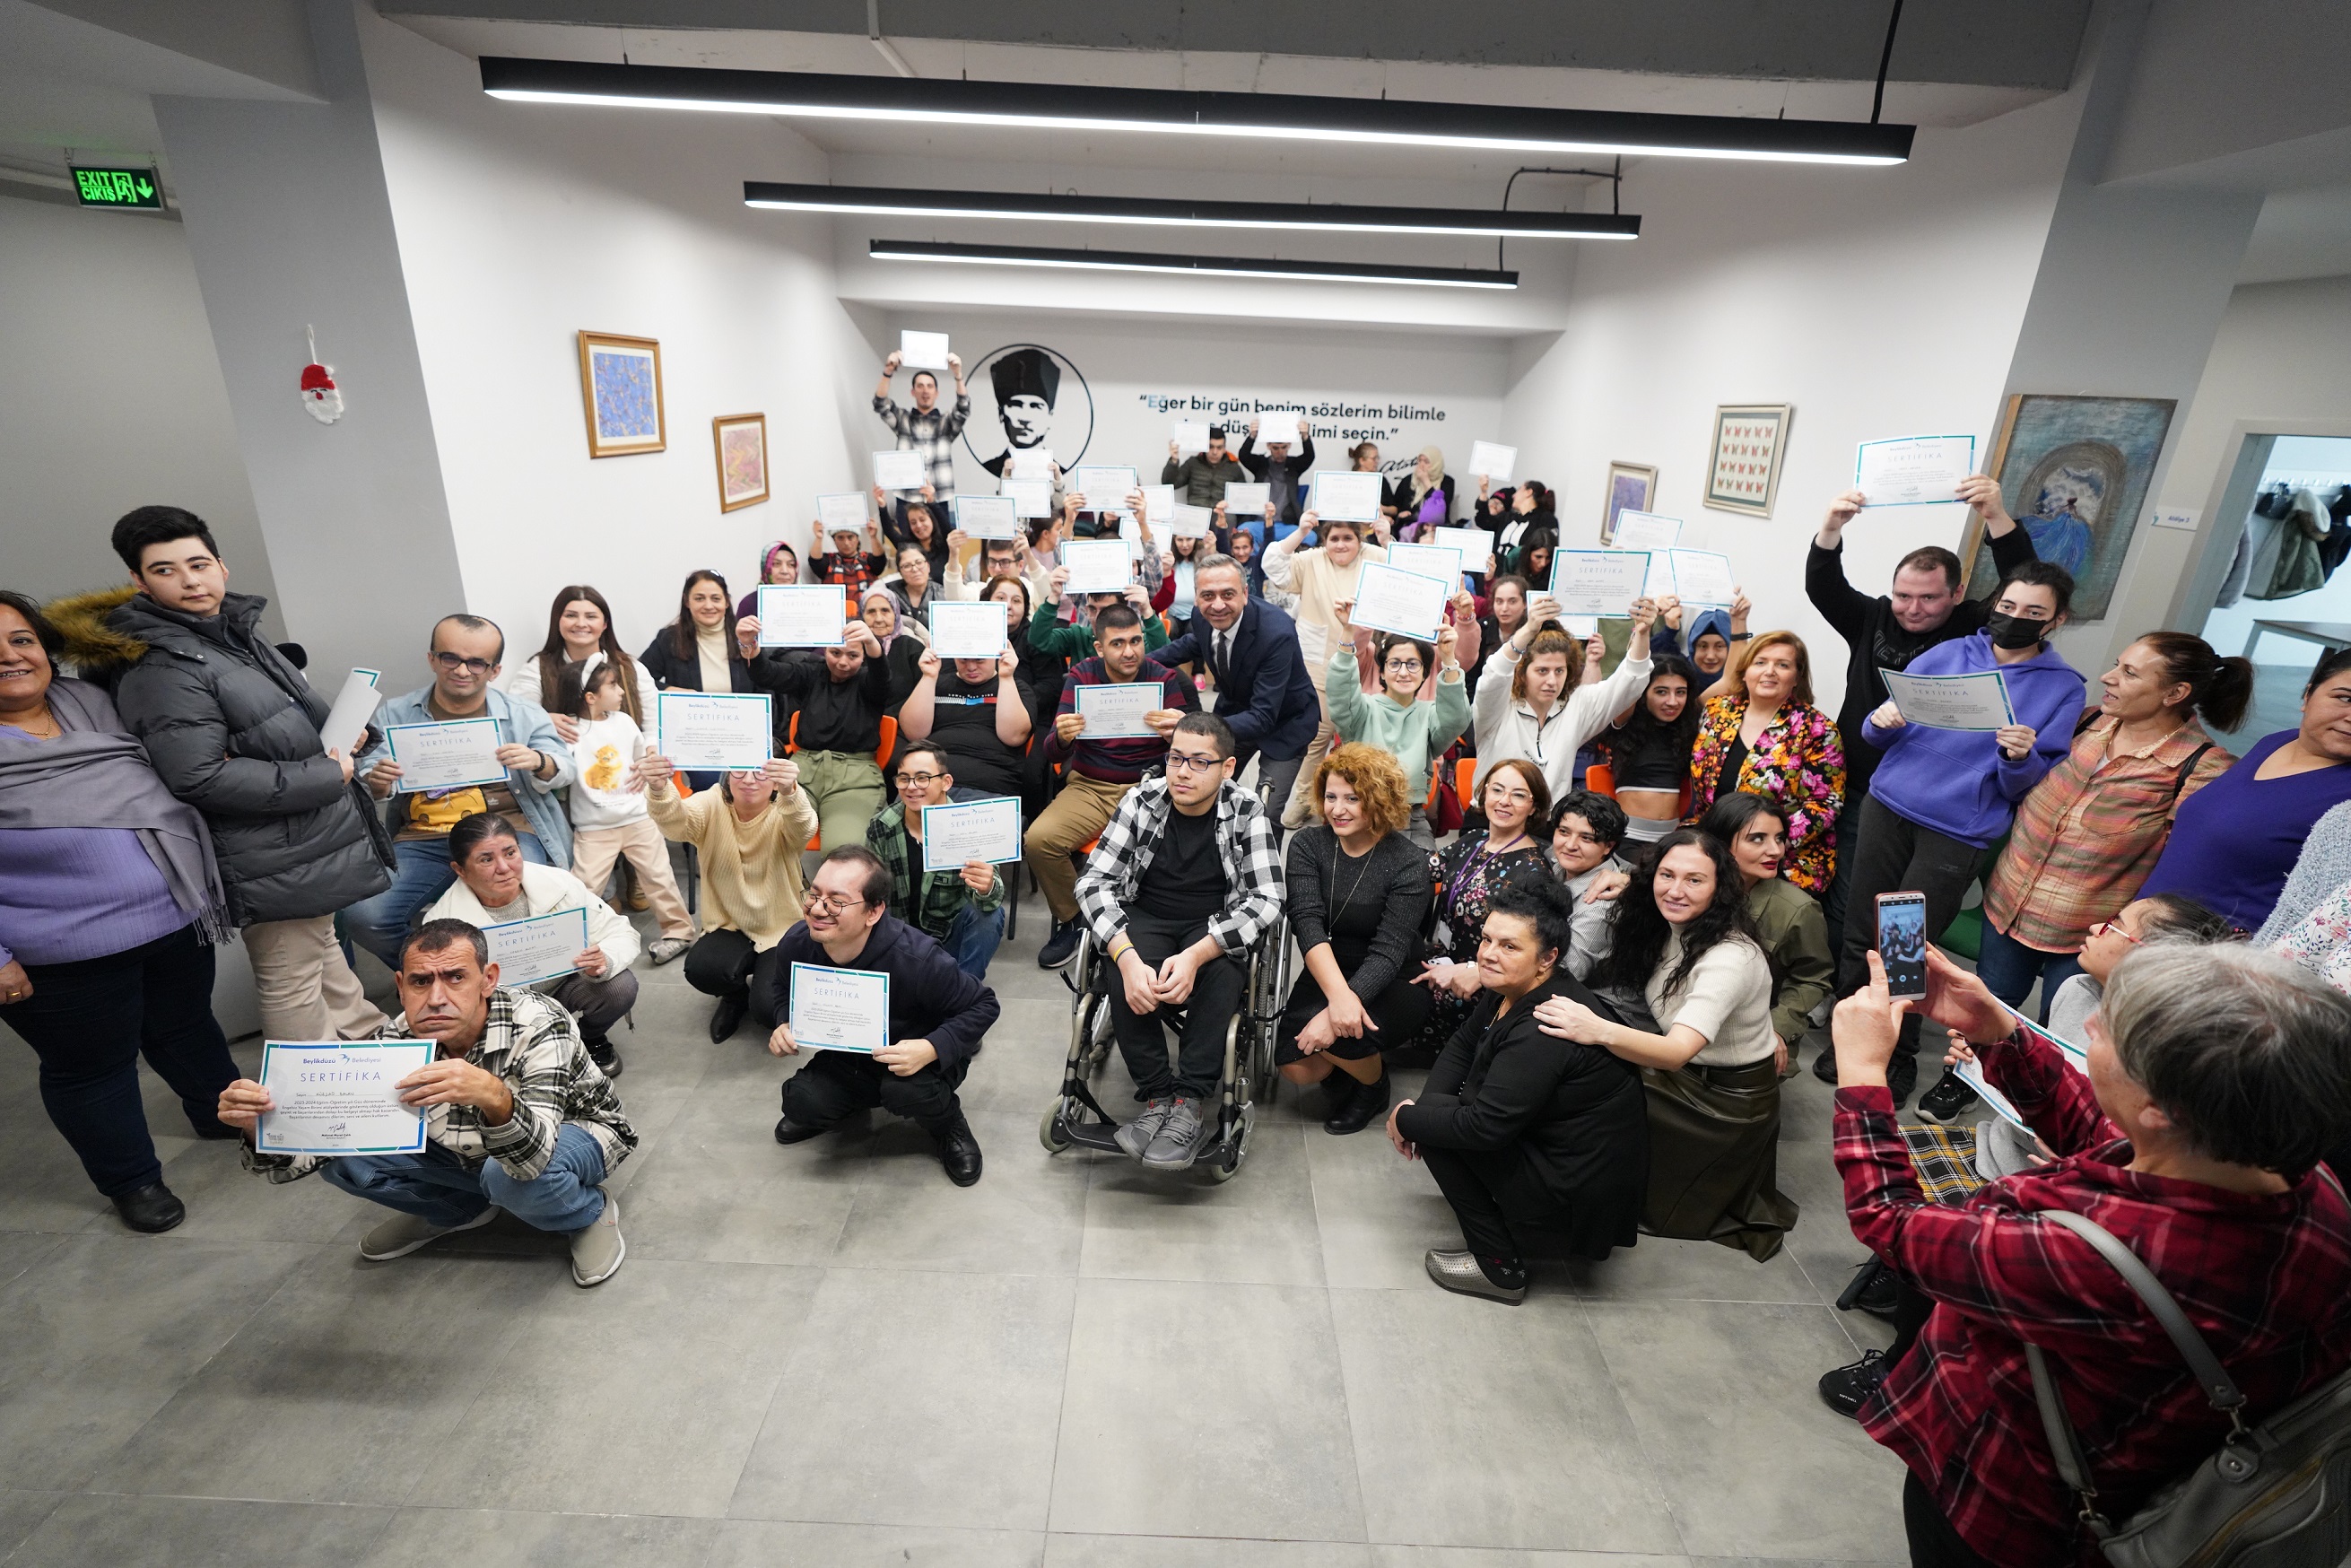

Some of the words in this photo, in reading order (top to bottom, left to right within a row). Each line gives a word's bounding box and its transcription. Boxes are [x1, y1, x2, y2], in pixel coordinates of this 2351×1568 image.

[75, 170, 110, 186] EXIT
[1191, 396, 1215, 411] bir
[1218, 398, 1250, 415] gün
[1311, 403, 1382, 419] sözlerim
[1388, 405, 1446, 422] bilimle
[300, 1070, 381, 1083] SERTİFİKA
